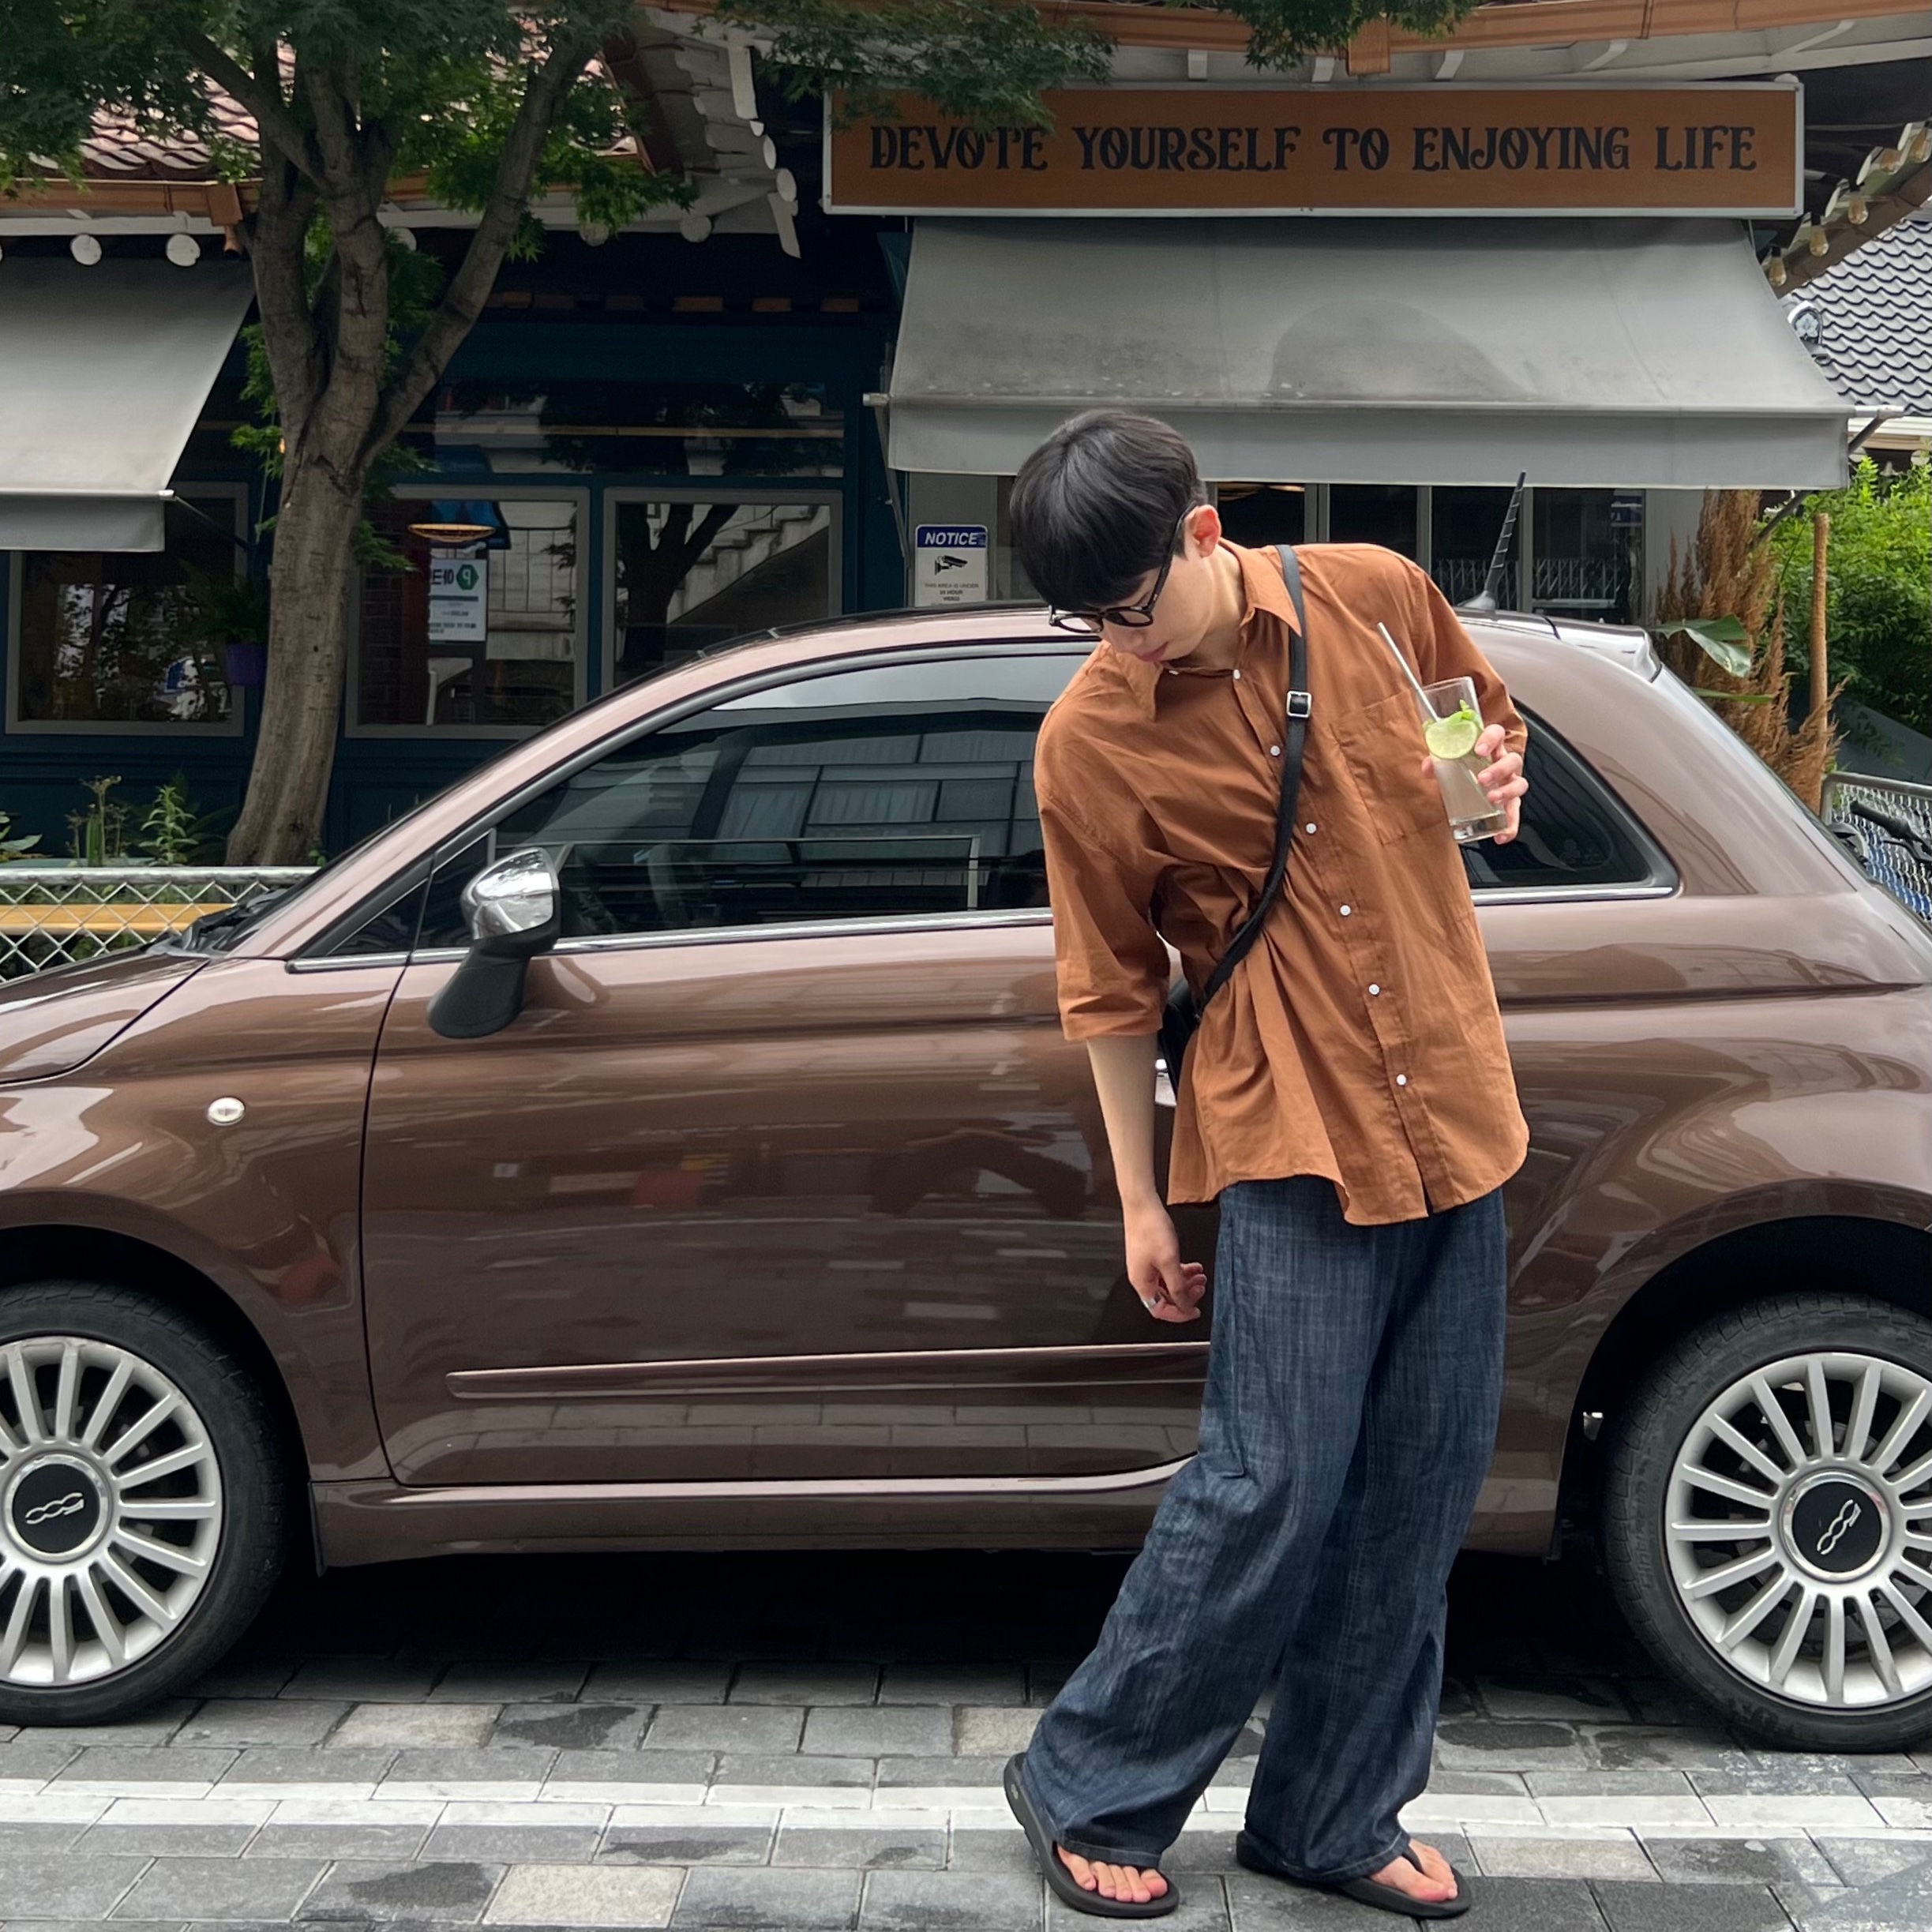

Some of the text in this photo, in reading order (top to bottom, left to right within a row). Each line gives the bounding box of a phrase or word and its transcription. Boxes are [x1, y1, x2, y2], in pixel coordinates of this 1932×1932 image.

[870, 126, 1757, 172] DEVOTE YOURSELF TO ENJOYING LIFE
[925, 531, 978, 546] NOTICE
